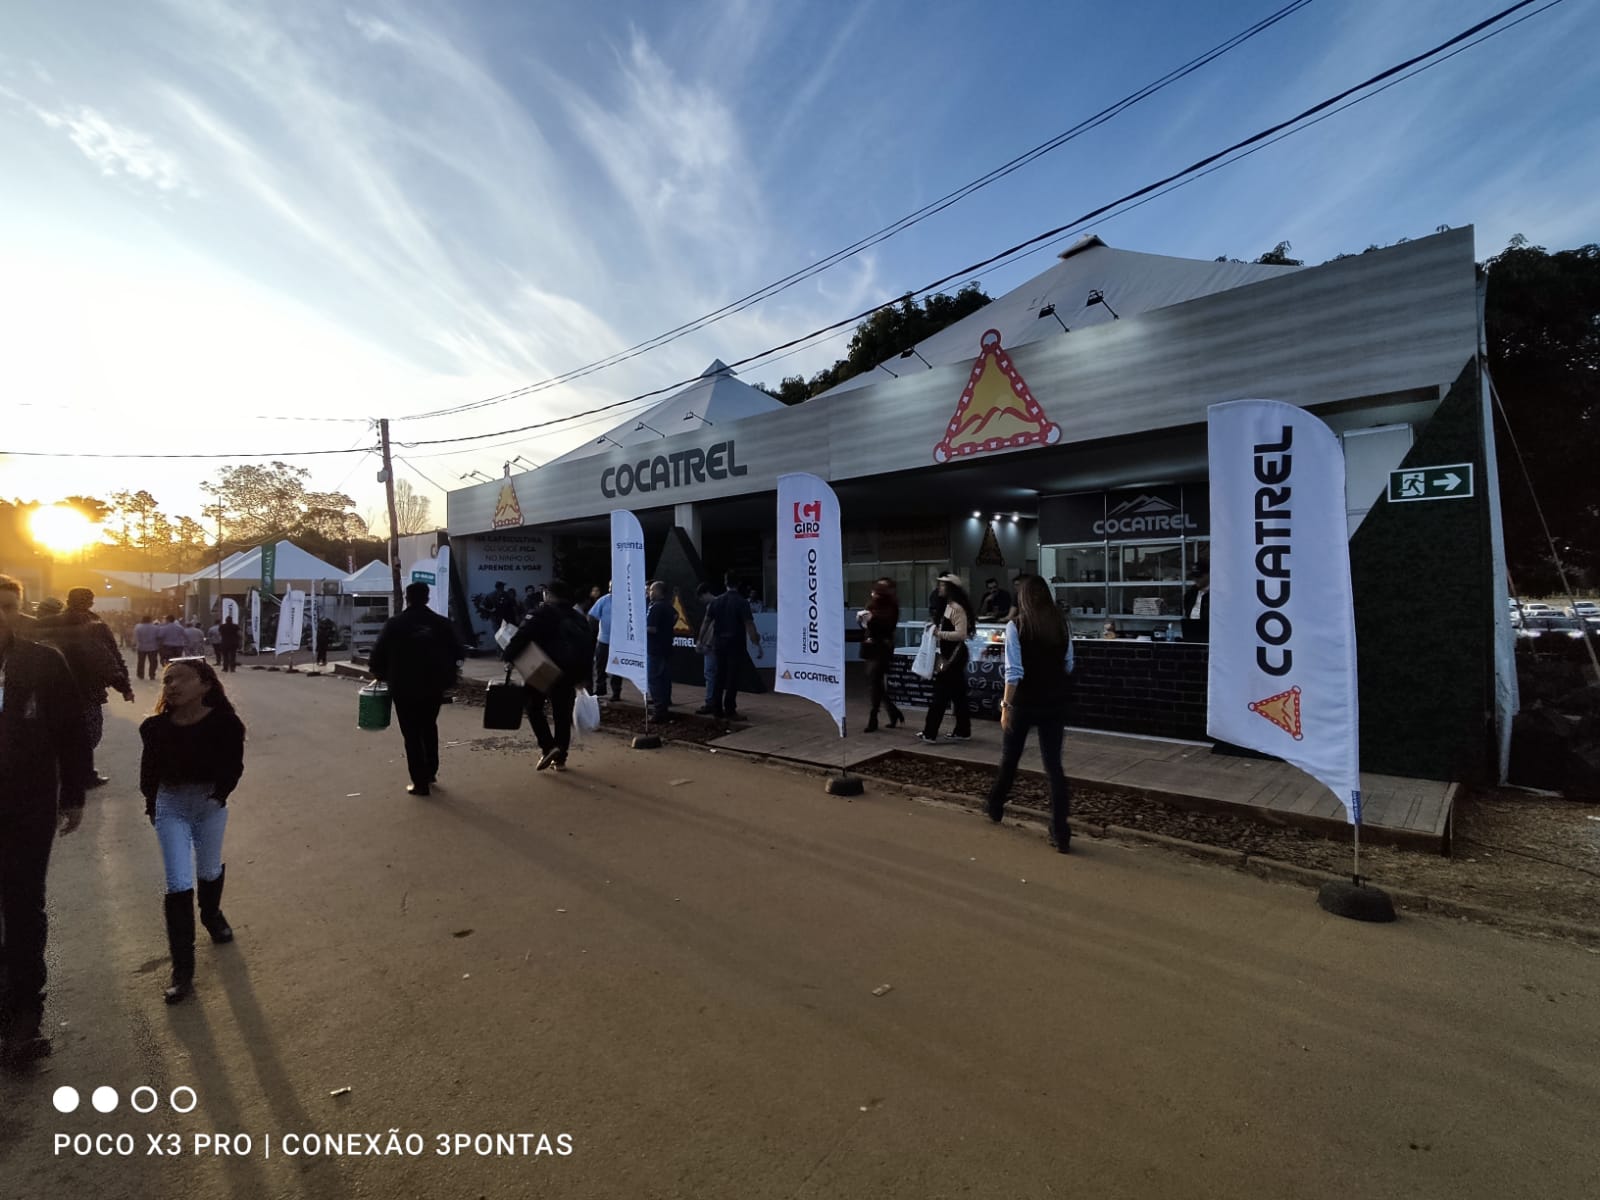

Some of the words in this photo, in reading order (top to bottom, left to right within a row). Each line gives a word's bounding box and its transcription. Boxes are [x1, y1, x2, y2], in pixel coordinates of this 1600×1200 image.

[600, 440, 748, 498] COCATREL
[794, 522, 820, 534] GIRO
[1093, 514, 1197, 534] COCATREL
[1254, 425, 1293, 677] COCATREL
[808, 548, 820, 654] GIROAGRO
[794, 670, 840, 684] COCATREL
